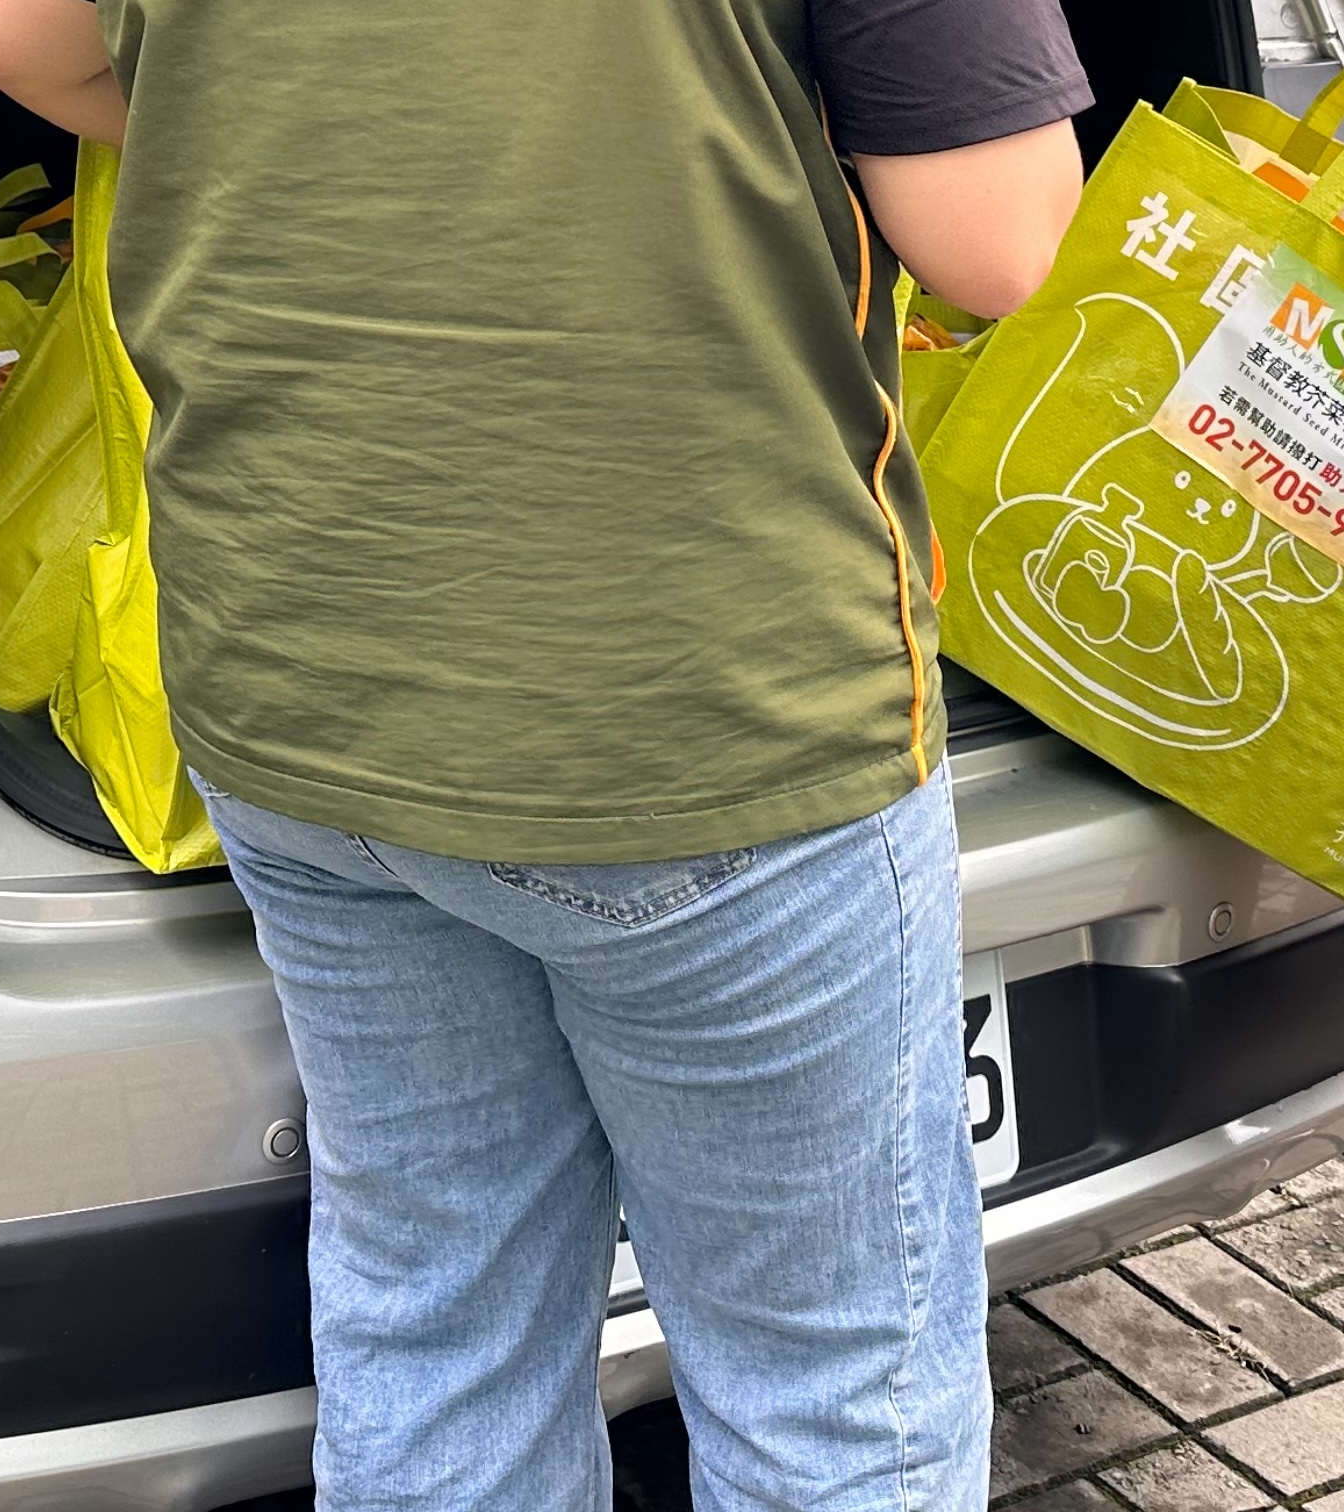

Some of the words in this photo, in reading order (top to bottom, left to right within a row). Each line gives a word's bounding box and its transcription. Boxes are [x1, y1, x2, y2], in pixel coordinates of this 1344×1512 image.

[1219, 385, 1322, 471] 若需幫助請撥打
[1238, 361, 1257, 381] The
[1258, 377, 1303, 416] Mustard
[1303, 413, 1329, 436] Seed
